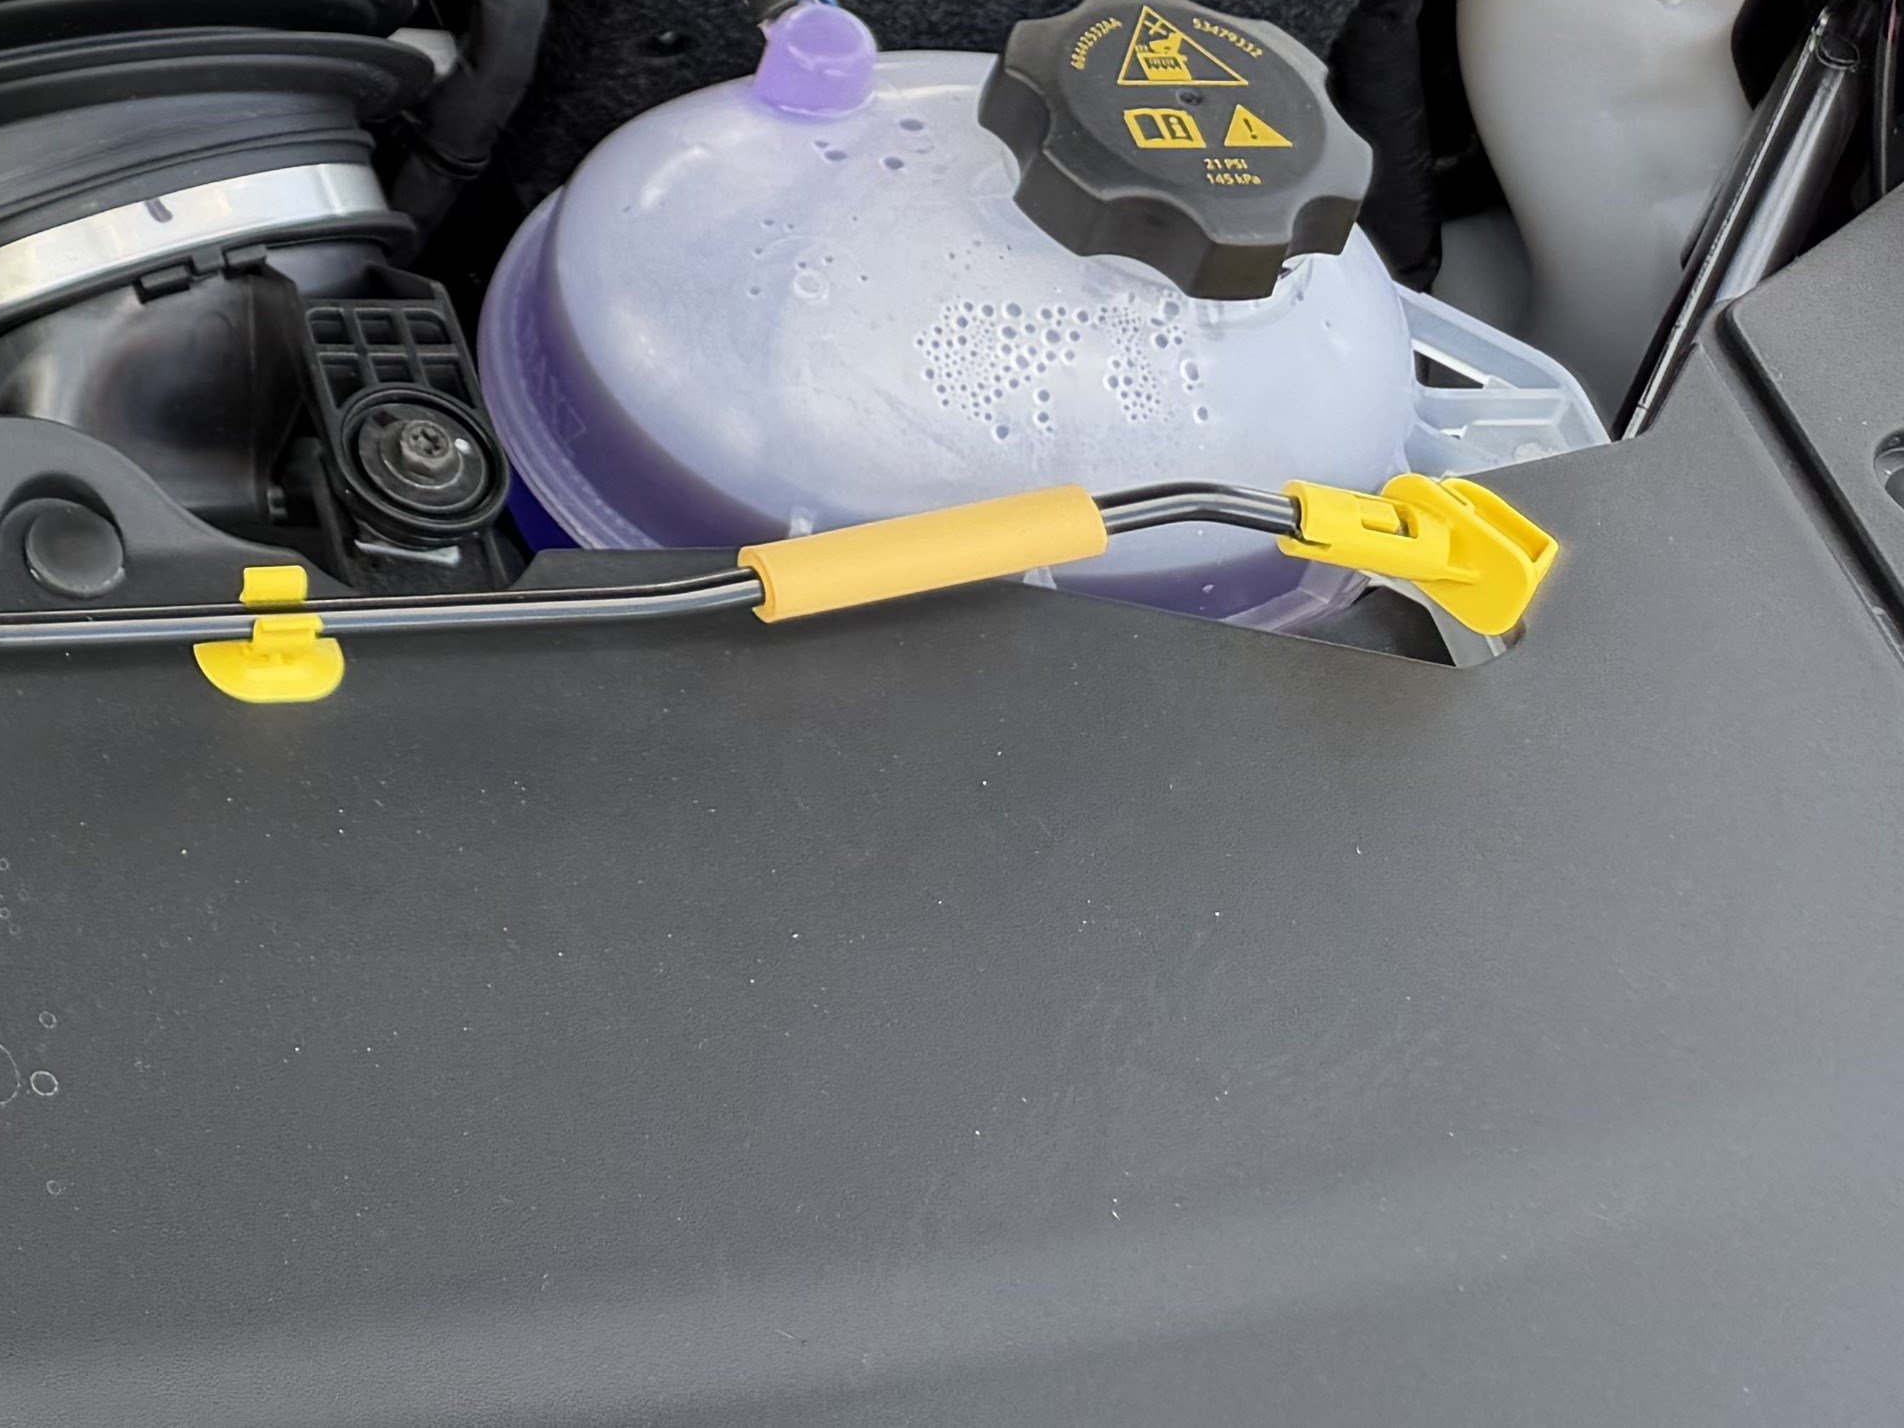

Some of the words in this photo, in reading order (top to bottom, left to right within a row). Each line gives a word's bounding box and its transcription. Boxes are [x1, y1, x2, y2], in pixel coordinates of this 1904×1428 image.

[1204, 158, 1223, 170] 21
[1225, 158, 1248, 170] PSI
[1206, 172, 1234, 186] 145
[1235, 173, 1263, 186] kPa
